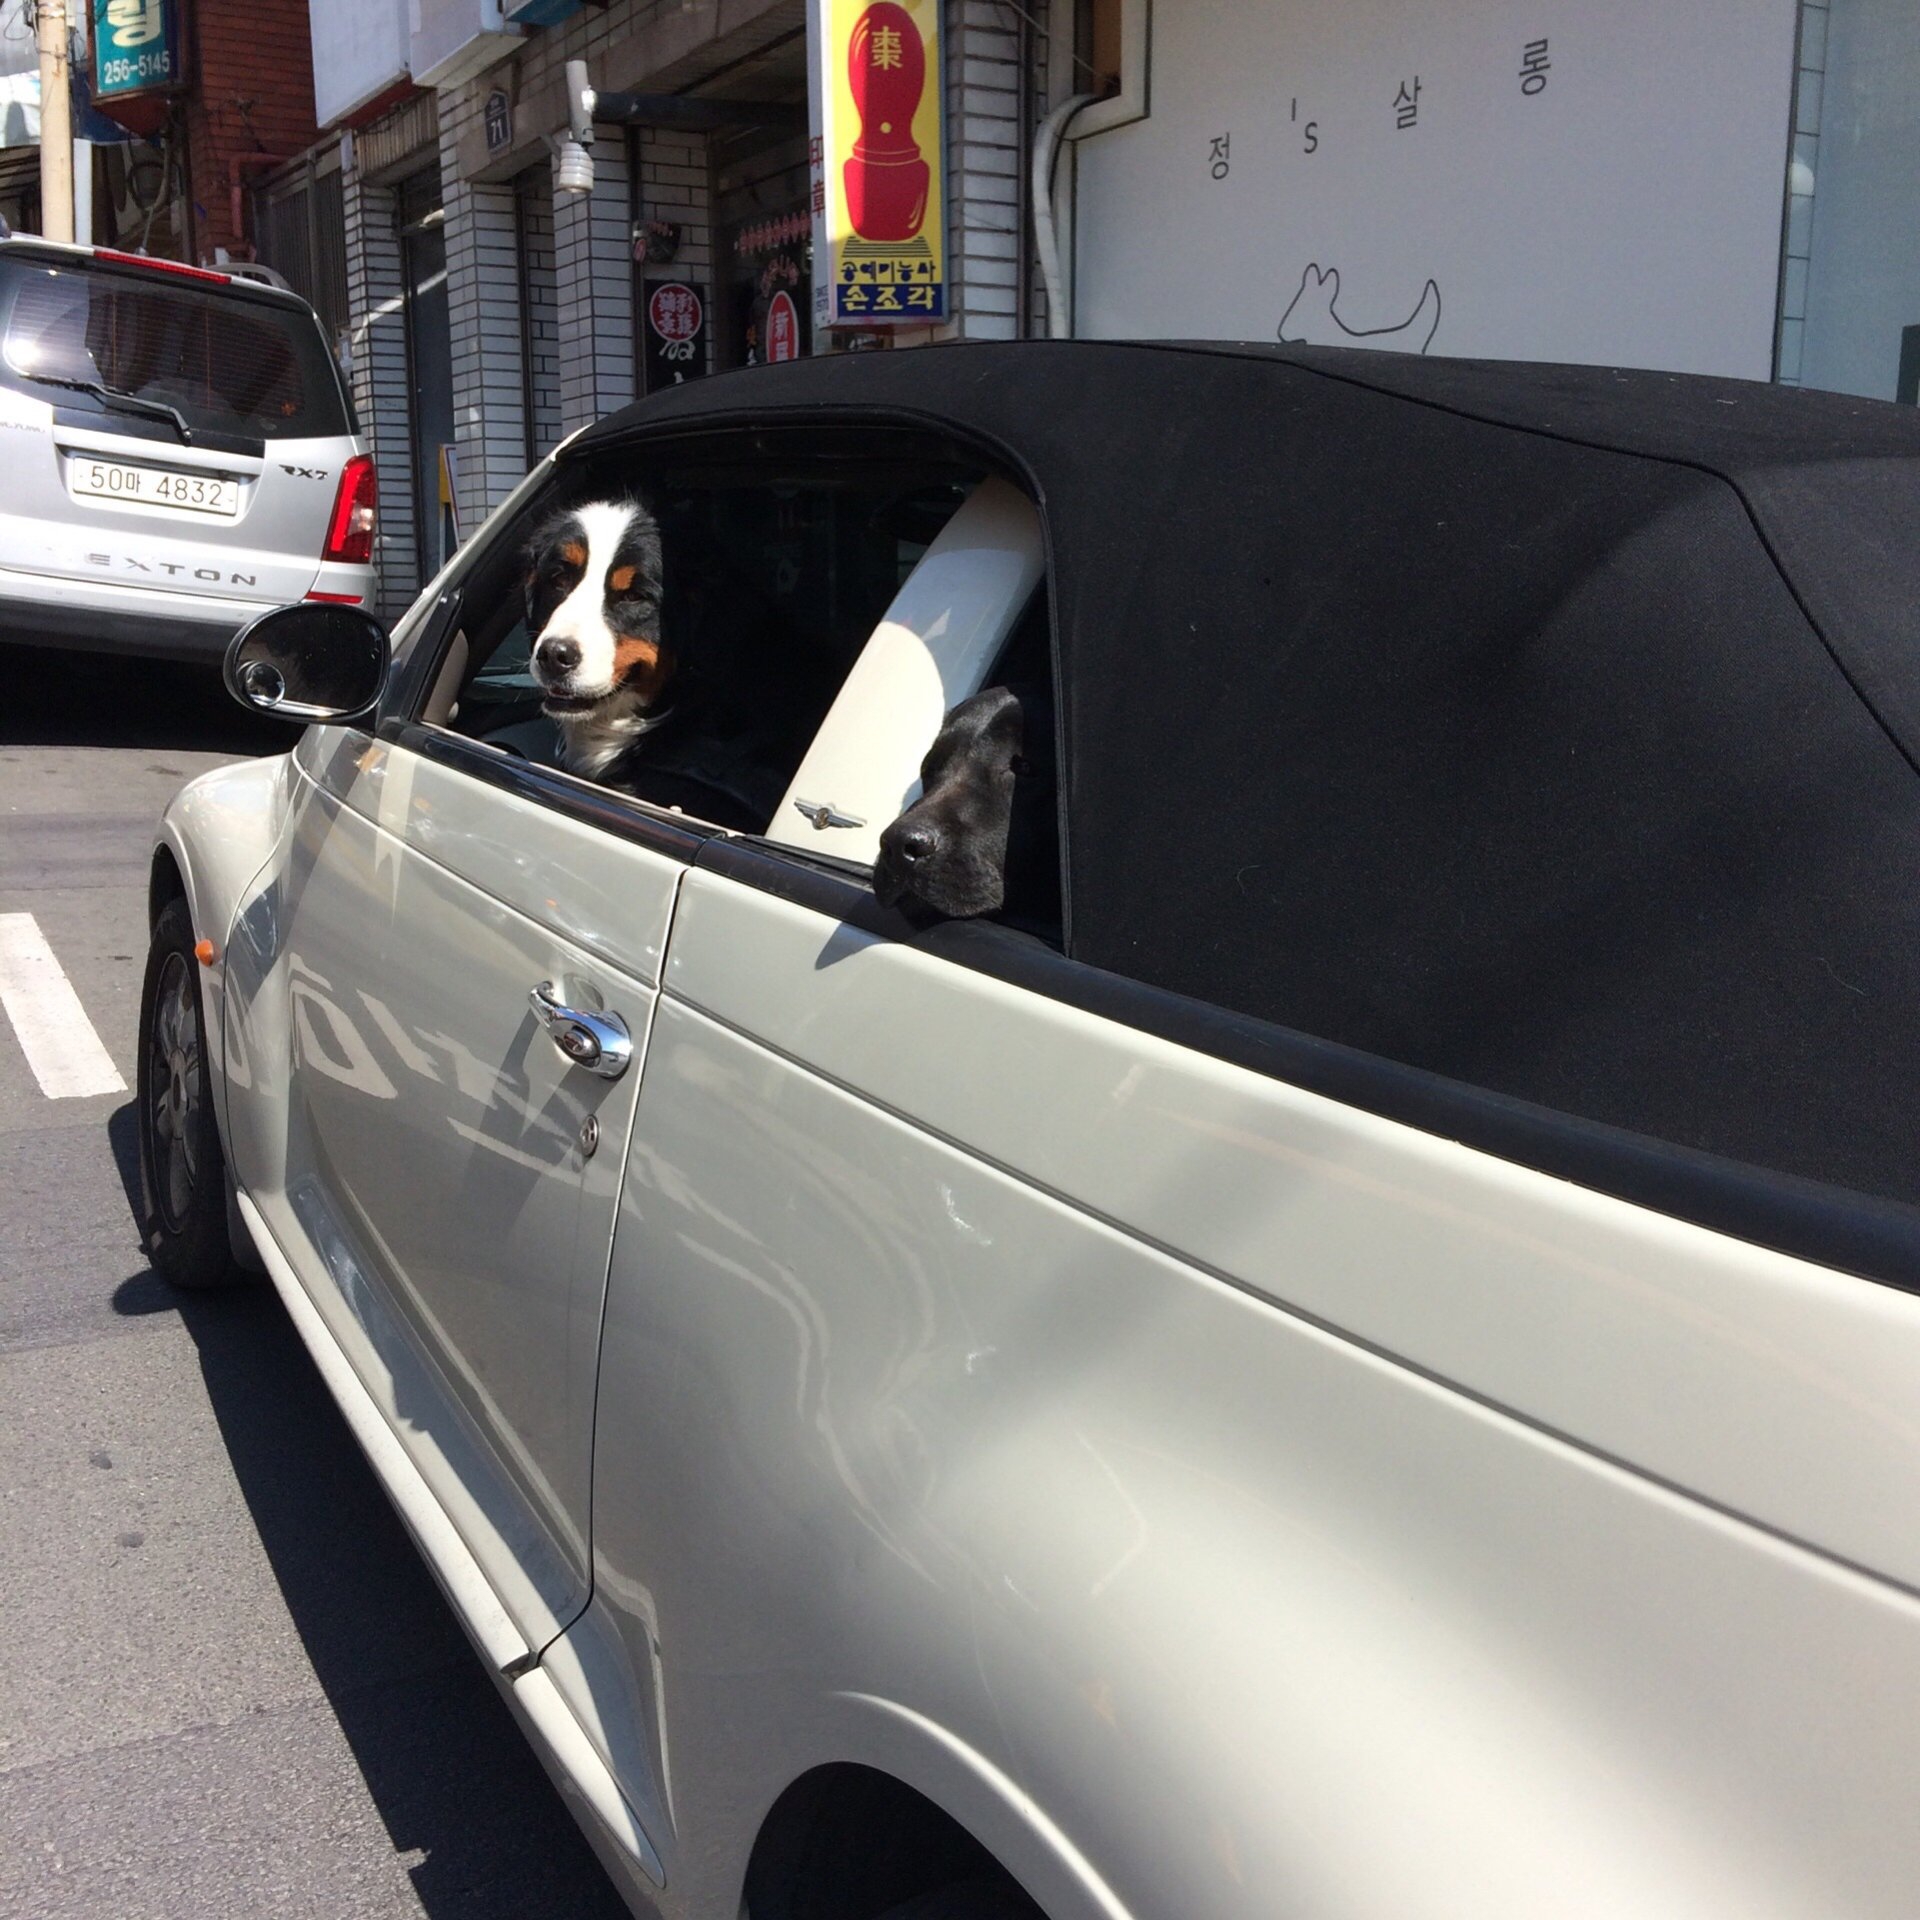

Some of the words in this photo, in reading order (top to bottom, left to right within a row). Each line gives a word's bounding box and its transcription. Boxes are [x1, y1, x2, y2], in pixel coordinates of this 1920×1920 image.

[104, 50, 170, 84] 256-5145
[1392, 38, 1551, 131] 살롱
[841, 285, 936, 312] 손조각
[90, 465, 141, 494] 50마
[155, 480, 223, 507] 4832
[80, 551, 257, 588] EXTON
